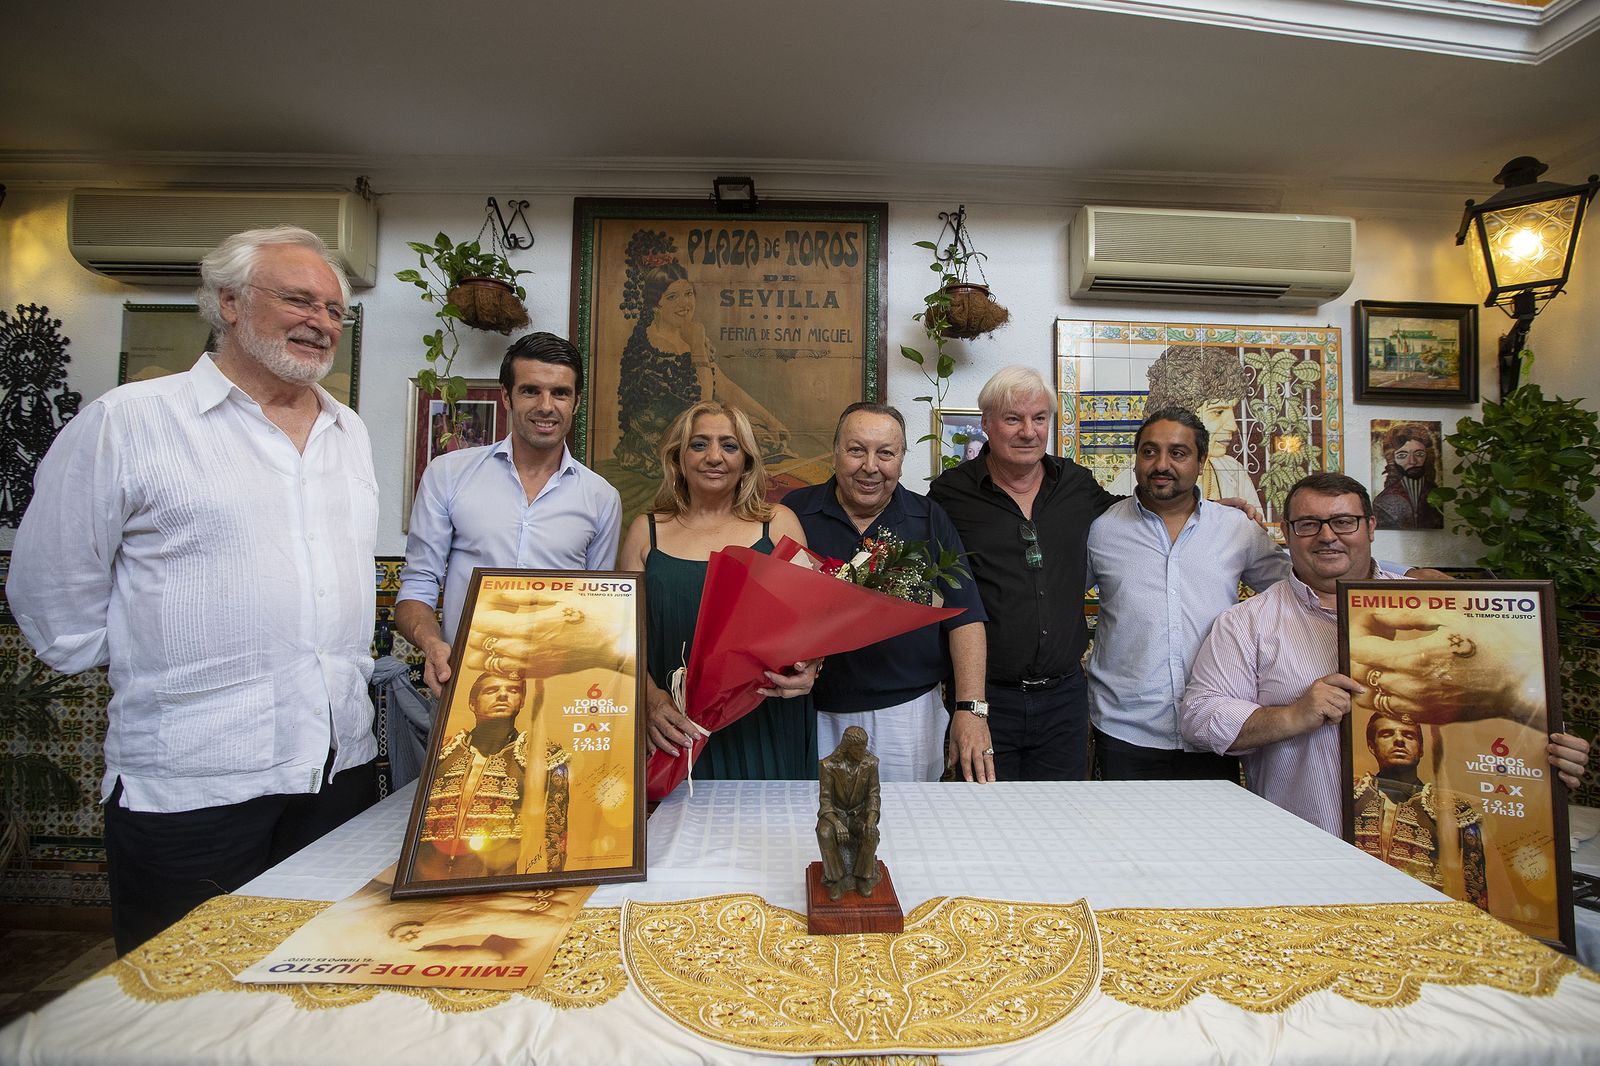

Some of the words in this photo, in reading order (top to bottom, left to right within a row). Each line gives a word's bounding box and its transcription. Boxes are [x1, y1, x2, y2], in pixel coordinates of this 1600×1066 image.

[687, 228, 760, 269] PLAZA
[763, 237, 780, 259] DE
[785, 230, 859, 268] TOROS
[763, 274, 796, 282] DE
[720, 289, 840, 309] SEVILLA
[720, 327, 757, 341] FERIA
[761, 328, 770, 341] DE
[774, 328, 801, 342] SAN
[808, 328, 853, 343] MIGUEL
[483, 580, 546, 591] EMILIO
[551, 582, 574, 592] DE
[578, 583, 633, 593] JUSTO
[1351, 595, 1421, 610] EMILIO
[1428, 597, 1457, 610] DE
[1463, 597, 1536, 613] JUSTO
[587, 683, 602, 699] 6
[562, 705, 628, 714] VICTORINO
[574, 699, 614, 707] TOROS
[573, 722, 611, 733] DAX
[572, 737, 611, 745] 7.9.19
[572, 743, 610, 752] 17h30
[1490, 737, 1510, 757] 6
[1477, 754, 1525, 768] TOROS
[1465, 761, 1543, 778] VICTORINO
[1480, 781, 1524, 798] DAX
[1481, 798, 1525, 811] 7.9.19
[1482, 805, 1525, 818] 17h30
[268, 963, 369, 974] JUSTO
[370, 963, 417, 976] DE
[421, 965, 529, 978] EMILIO
